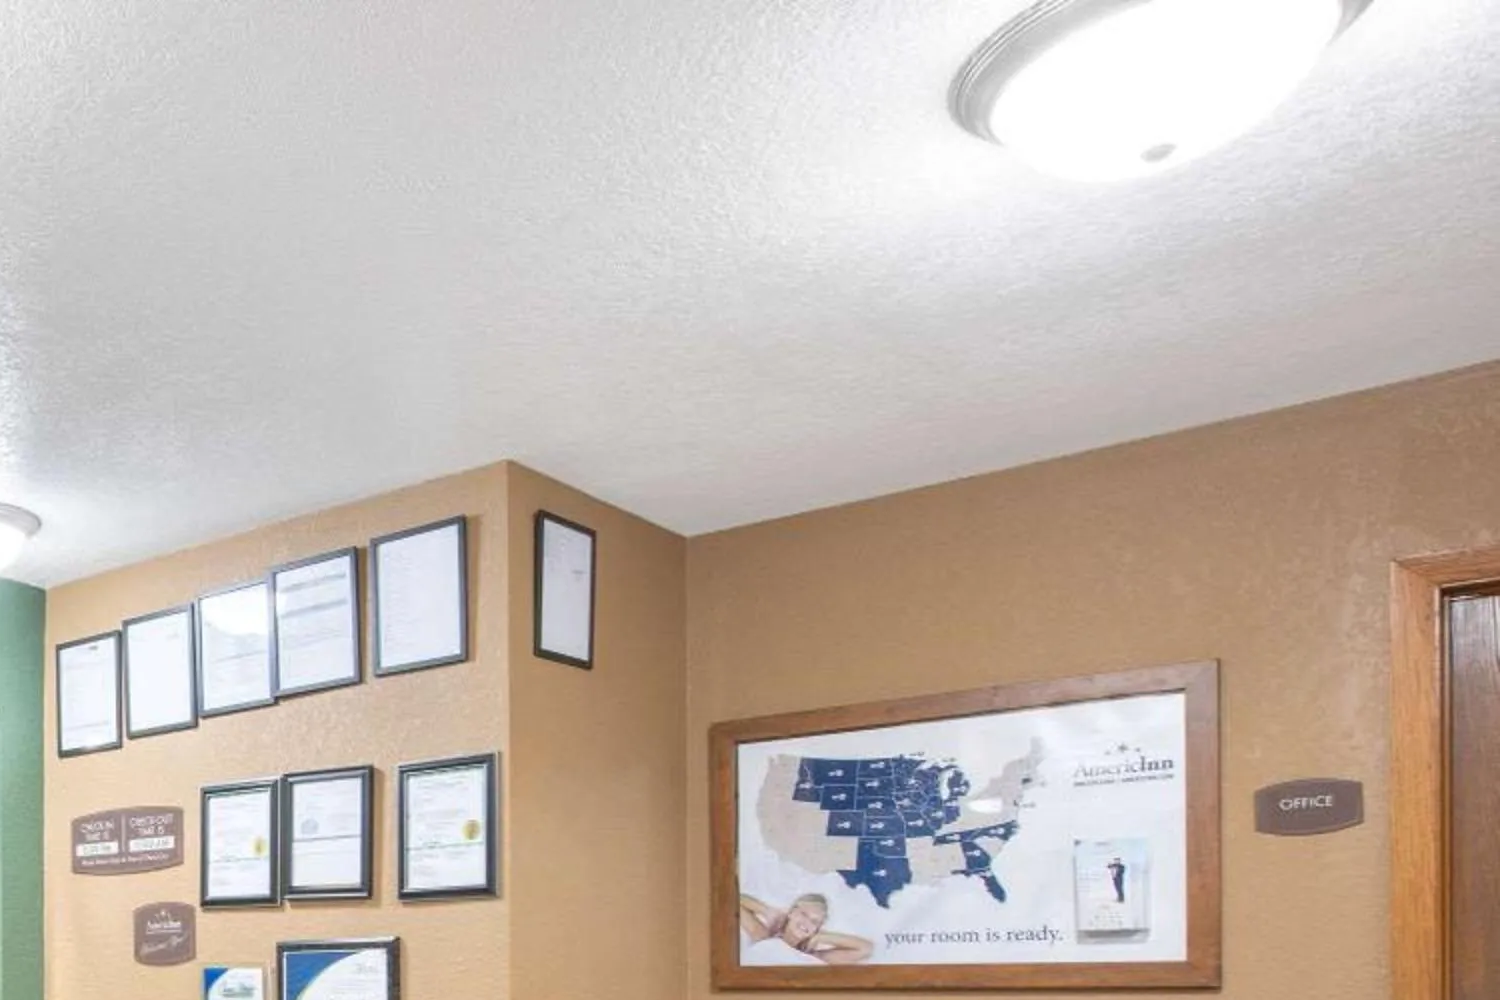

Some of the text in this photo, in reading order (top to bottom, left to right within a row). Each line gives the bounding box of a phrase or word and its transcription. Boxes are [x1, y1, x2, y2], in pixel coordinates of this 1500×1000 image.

[1278, 794, 1334, 812] OFFICE
[884, 924, 1064, 949] your room is ready.
